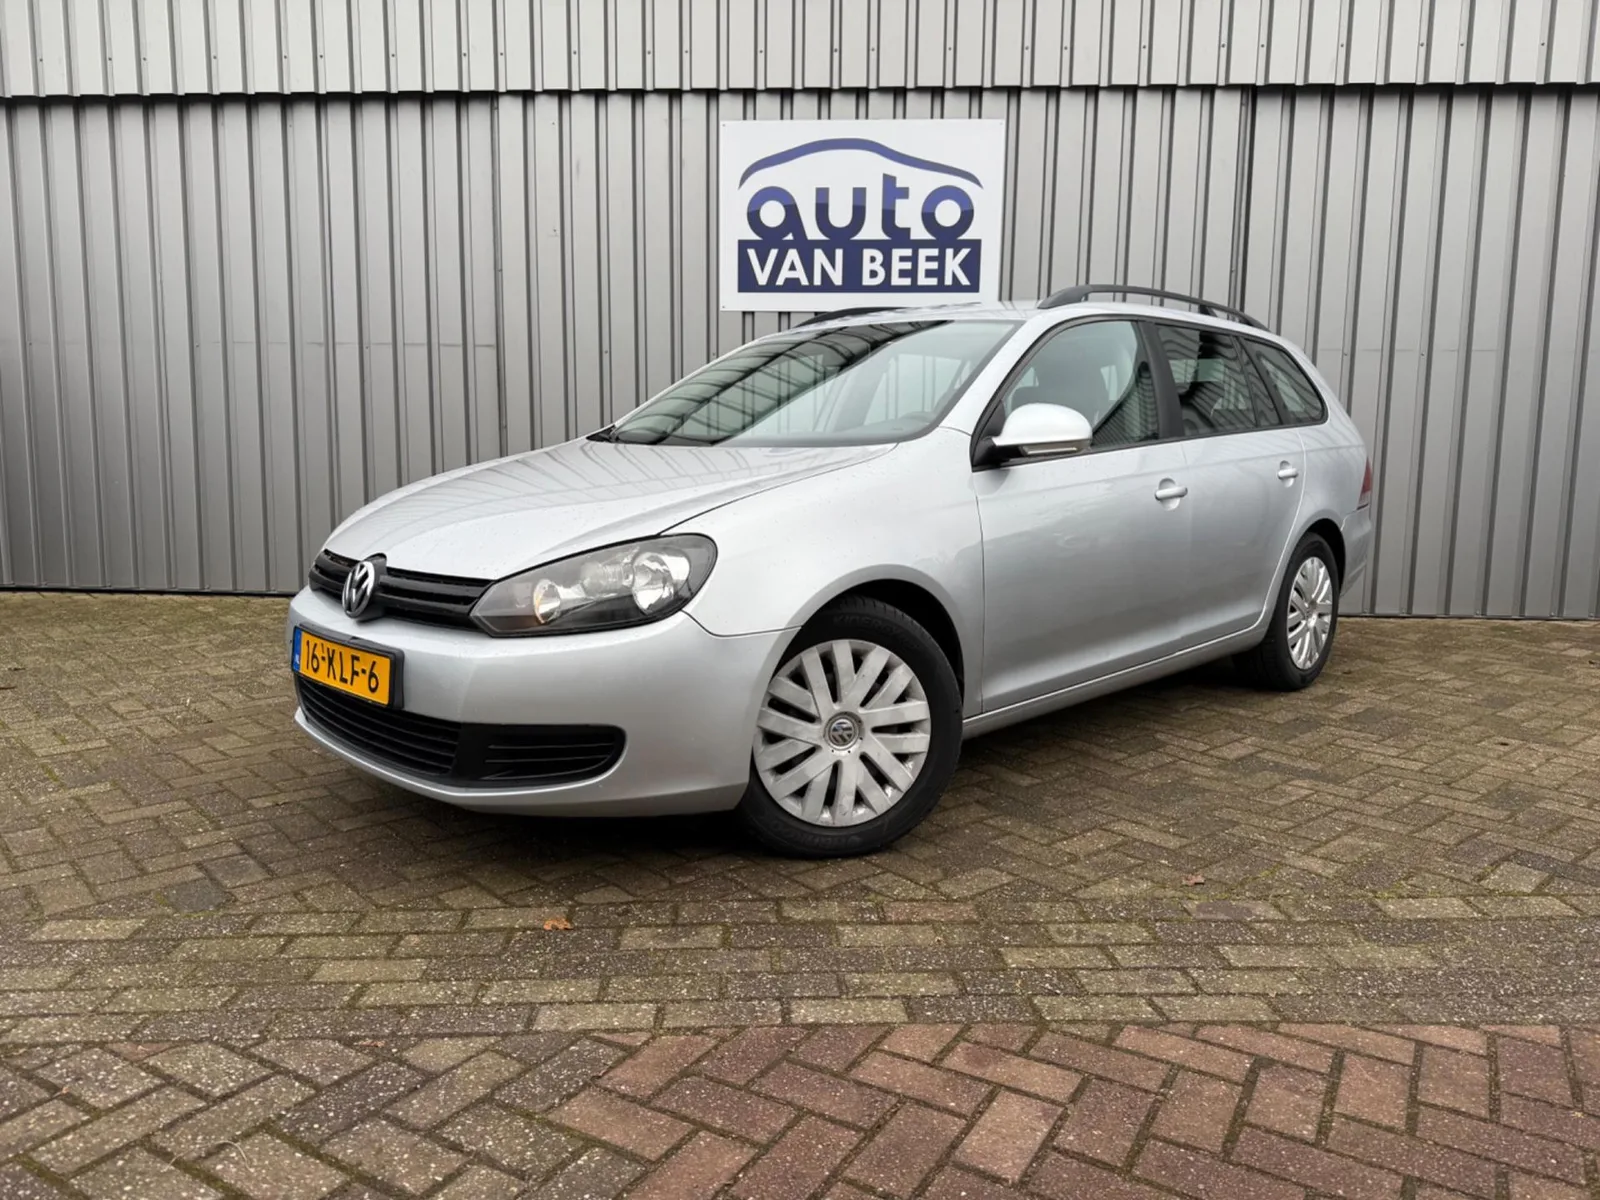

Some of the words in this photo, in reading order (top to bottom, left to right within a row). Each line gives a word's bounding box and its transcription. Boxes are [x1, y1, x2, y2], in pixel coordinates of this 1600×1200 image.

[747, 173, 974, 241] auto
[747, 248, 844, 286] VAN
[861, 248, 972, 286] BEEK
[305, 639, 380, 693] 16-KLF-6
